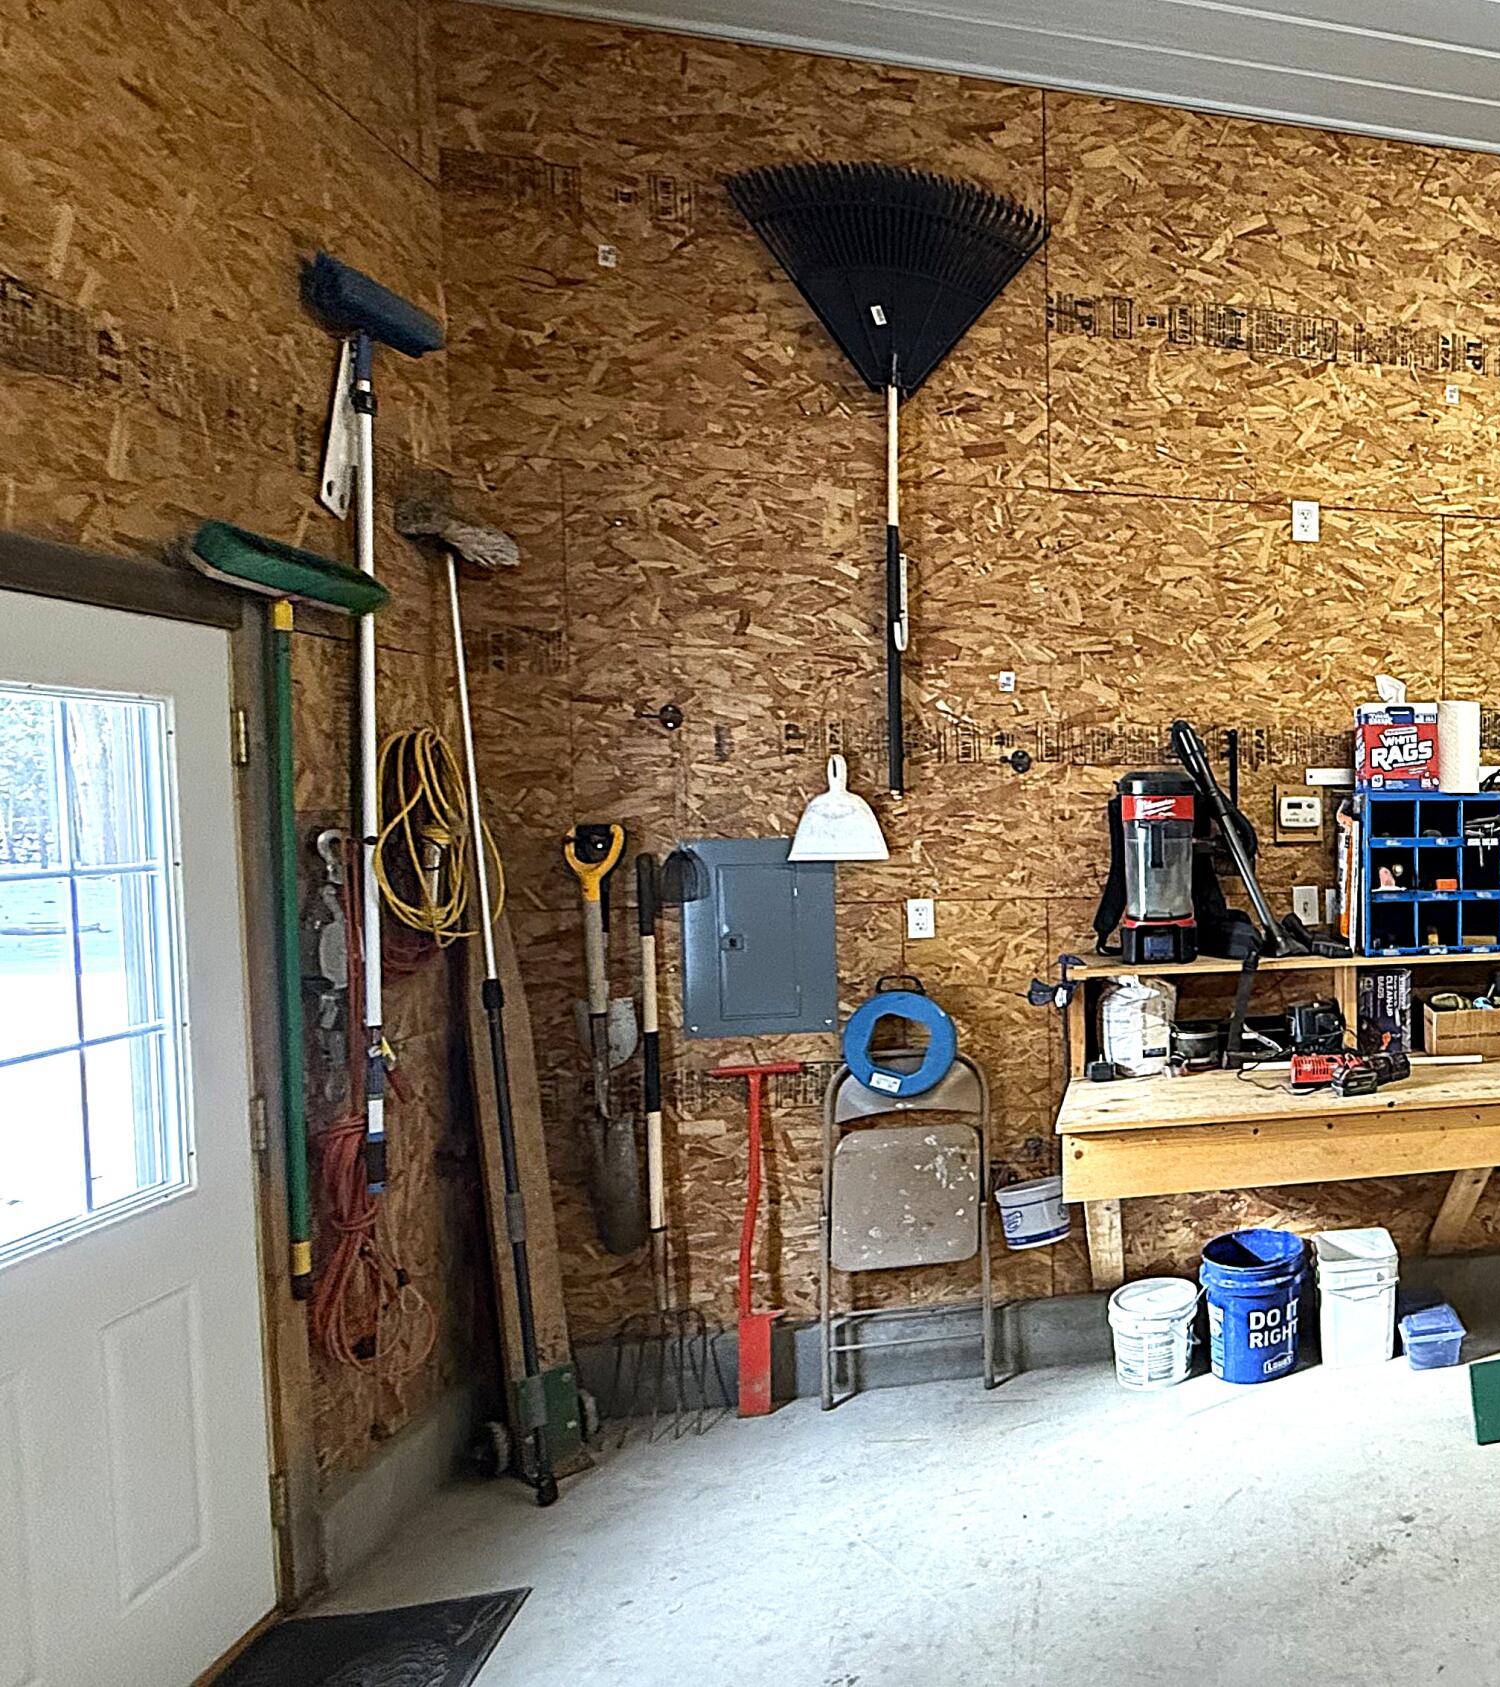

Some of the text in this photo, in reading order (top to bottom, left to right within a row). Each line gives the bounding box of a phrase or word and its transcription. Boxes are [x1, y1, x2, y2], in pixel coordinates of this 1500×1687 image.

[1440, 335, 1450, 369] APA
[1466, 341, 1483, 372] LP
[1254, 729, 1266, 762] APA
[1371, 741, 1433, 771] RAGS
[1379, 734, 1418, 747] WHITE
[1249, 1297, 1300, 1330] DO IT
[1249, 1317, 1299, 1349] RIGHT
